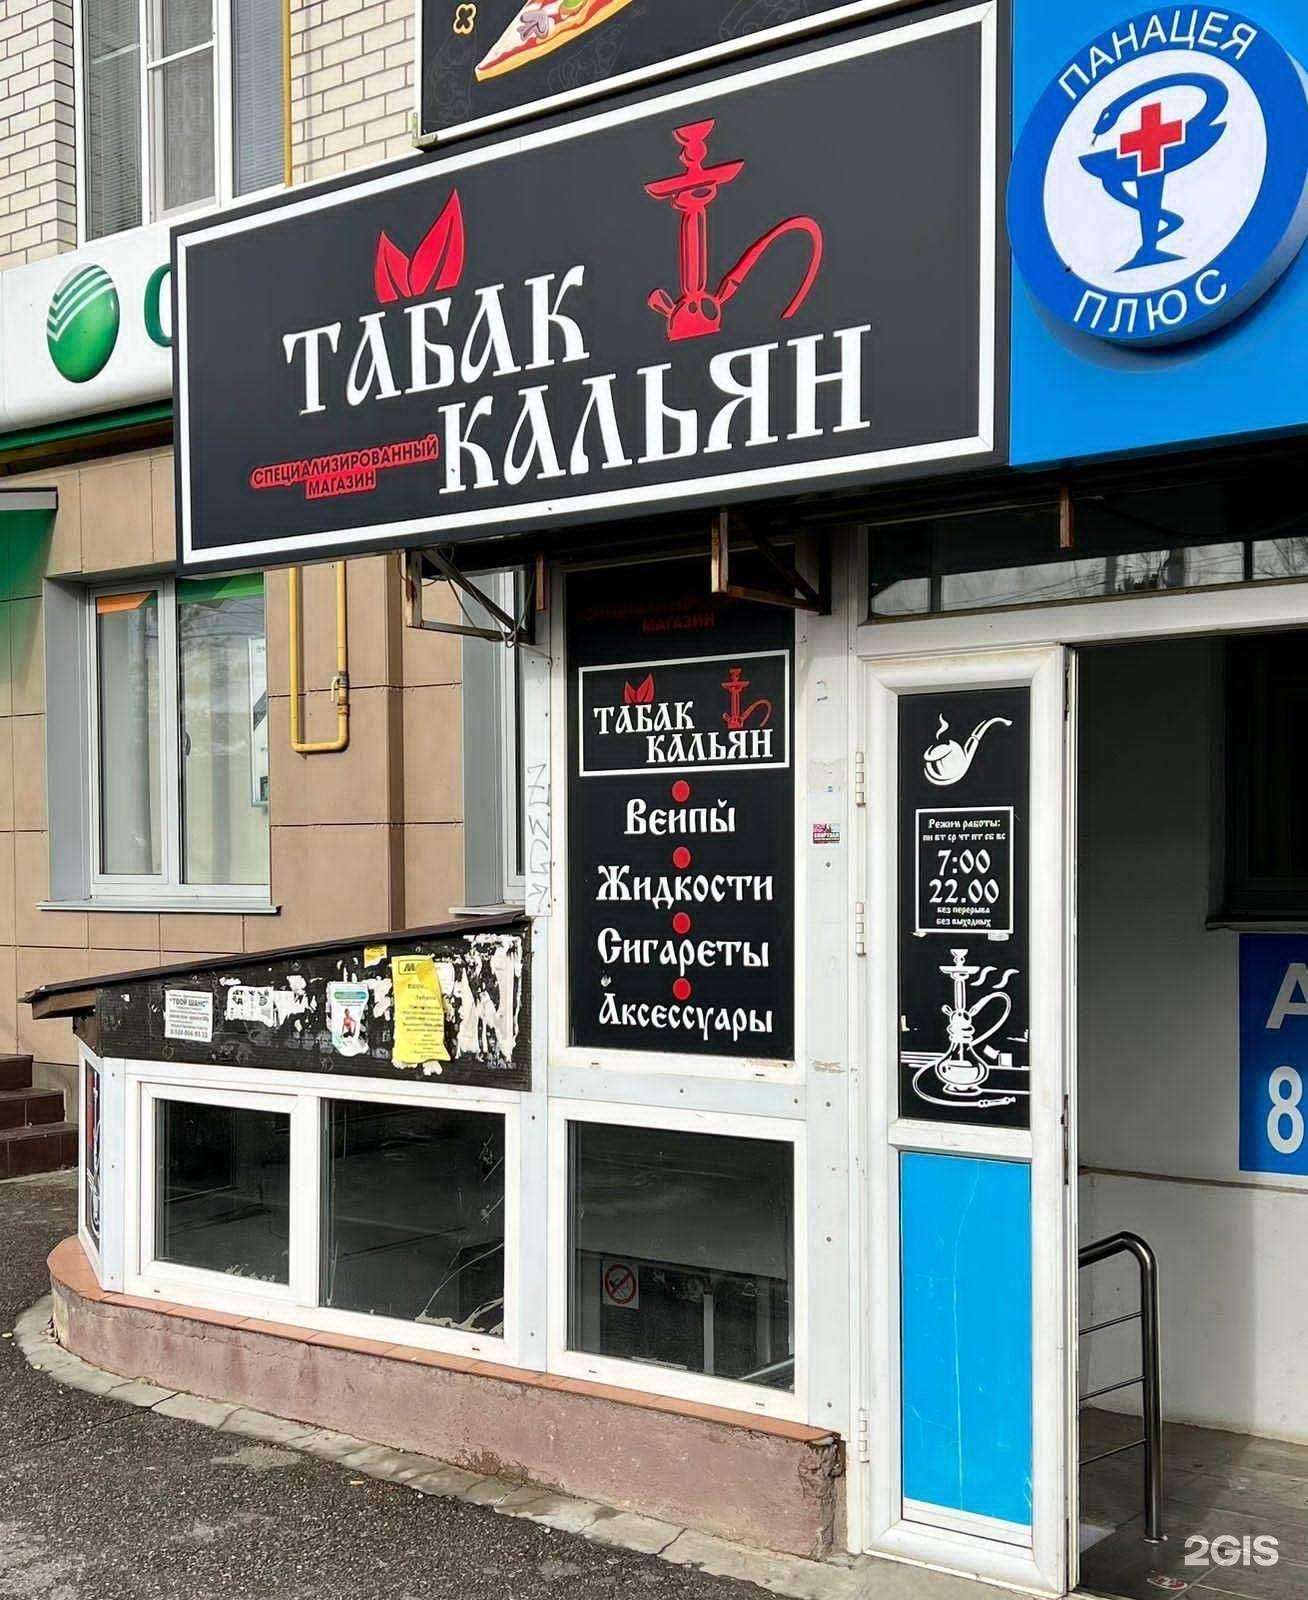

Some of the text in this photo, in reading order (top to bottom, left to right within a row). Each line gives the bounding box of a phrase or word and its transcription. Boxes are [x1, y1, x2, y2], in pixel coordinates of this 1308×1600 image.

[1058, 9, 1258, 101] ПАНАЦЕЯ
[1073, 268, 1228, 334] ПЛЮС
[282, 265, 590, 415] ТАБАК
[437, 324, 872, 495] КАЛЬЯН
[253, 435, 438, 485] СПЕЦИАЛИЗИРОВАННЫЙ
[308, 471, 375, 495] МАГАЗИН
[593, 700, 696, 735] ТАБАК
[645, 728, 774, 764] КАЛЬЯН
[947, 833, 958, 843] ср
[958, 833, 970, 841] чт
[963, 819, 1001, 831] работы:
[937, 848, 991, 877] 7:00
[595, 864, 773, 910] Жидкости
[928, 878, 1000, 904] 22.00
[952, 918, 992, 928] выходных
[597, 926, 769, 977] Сигареты
[598, 992, 773, 1042] Аксессуары
